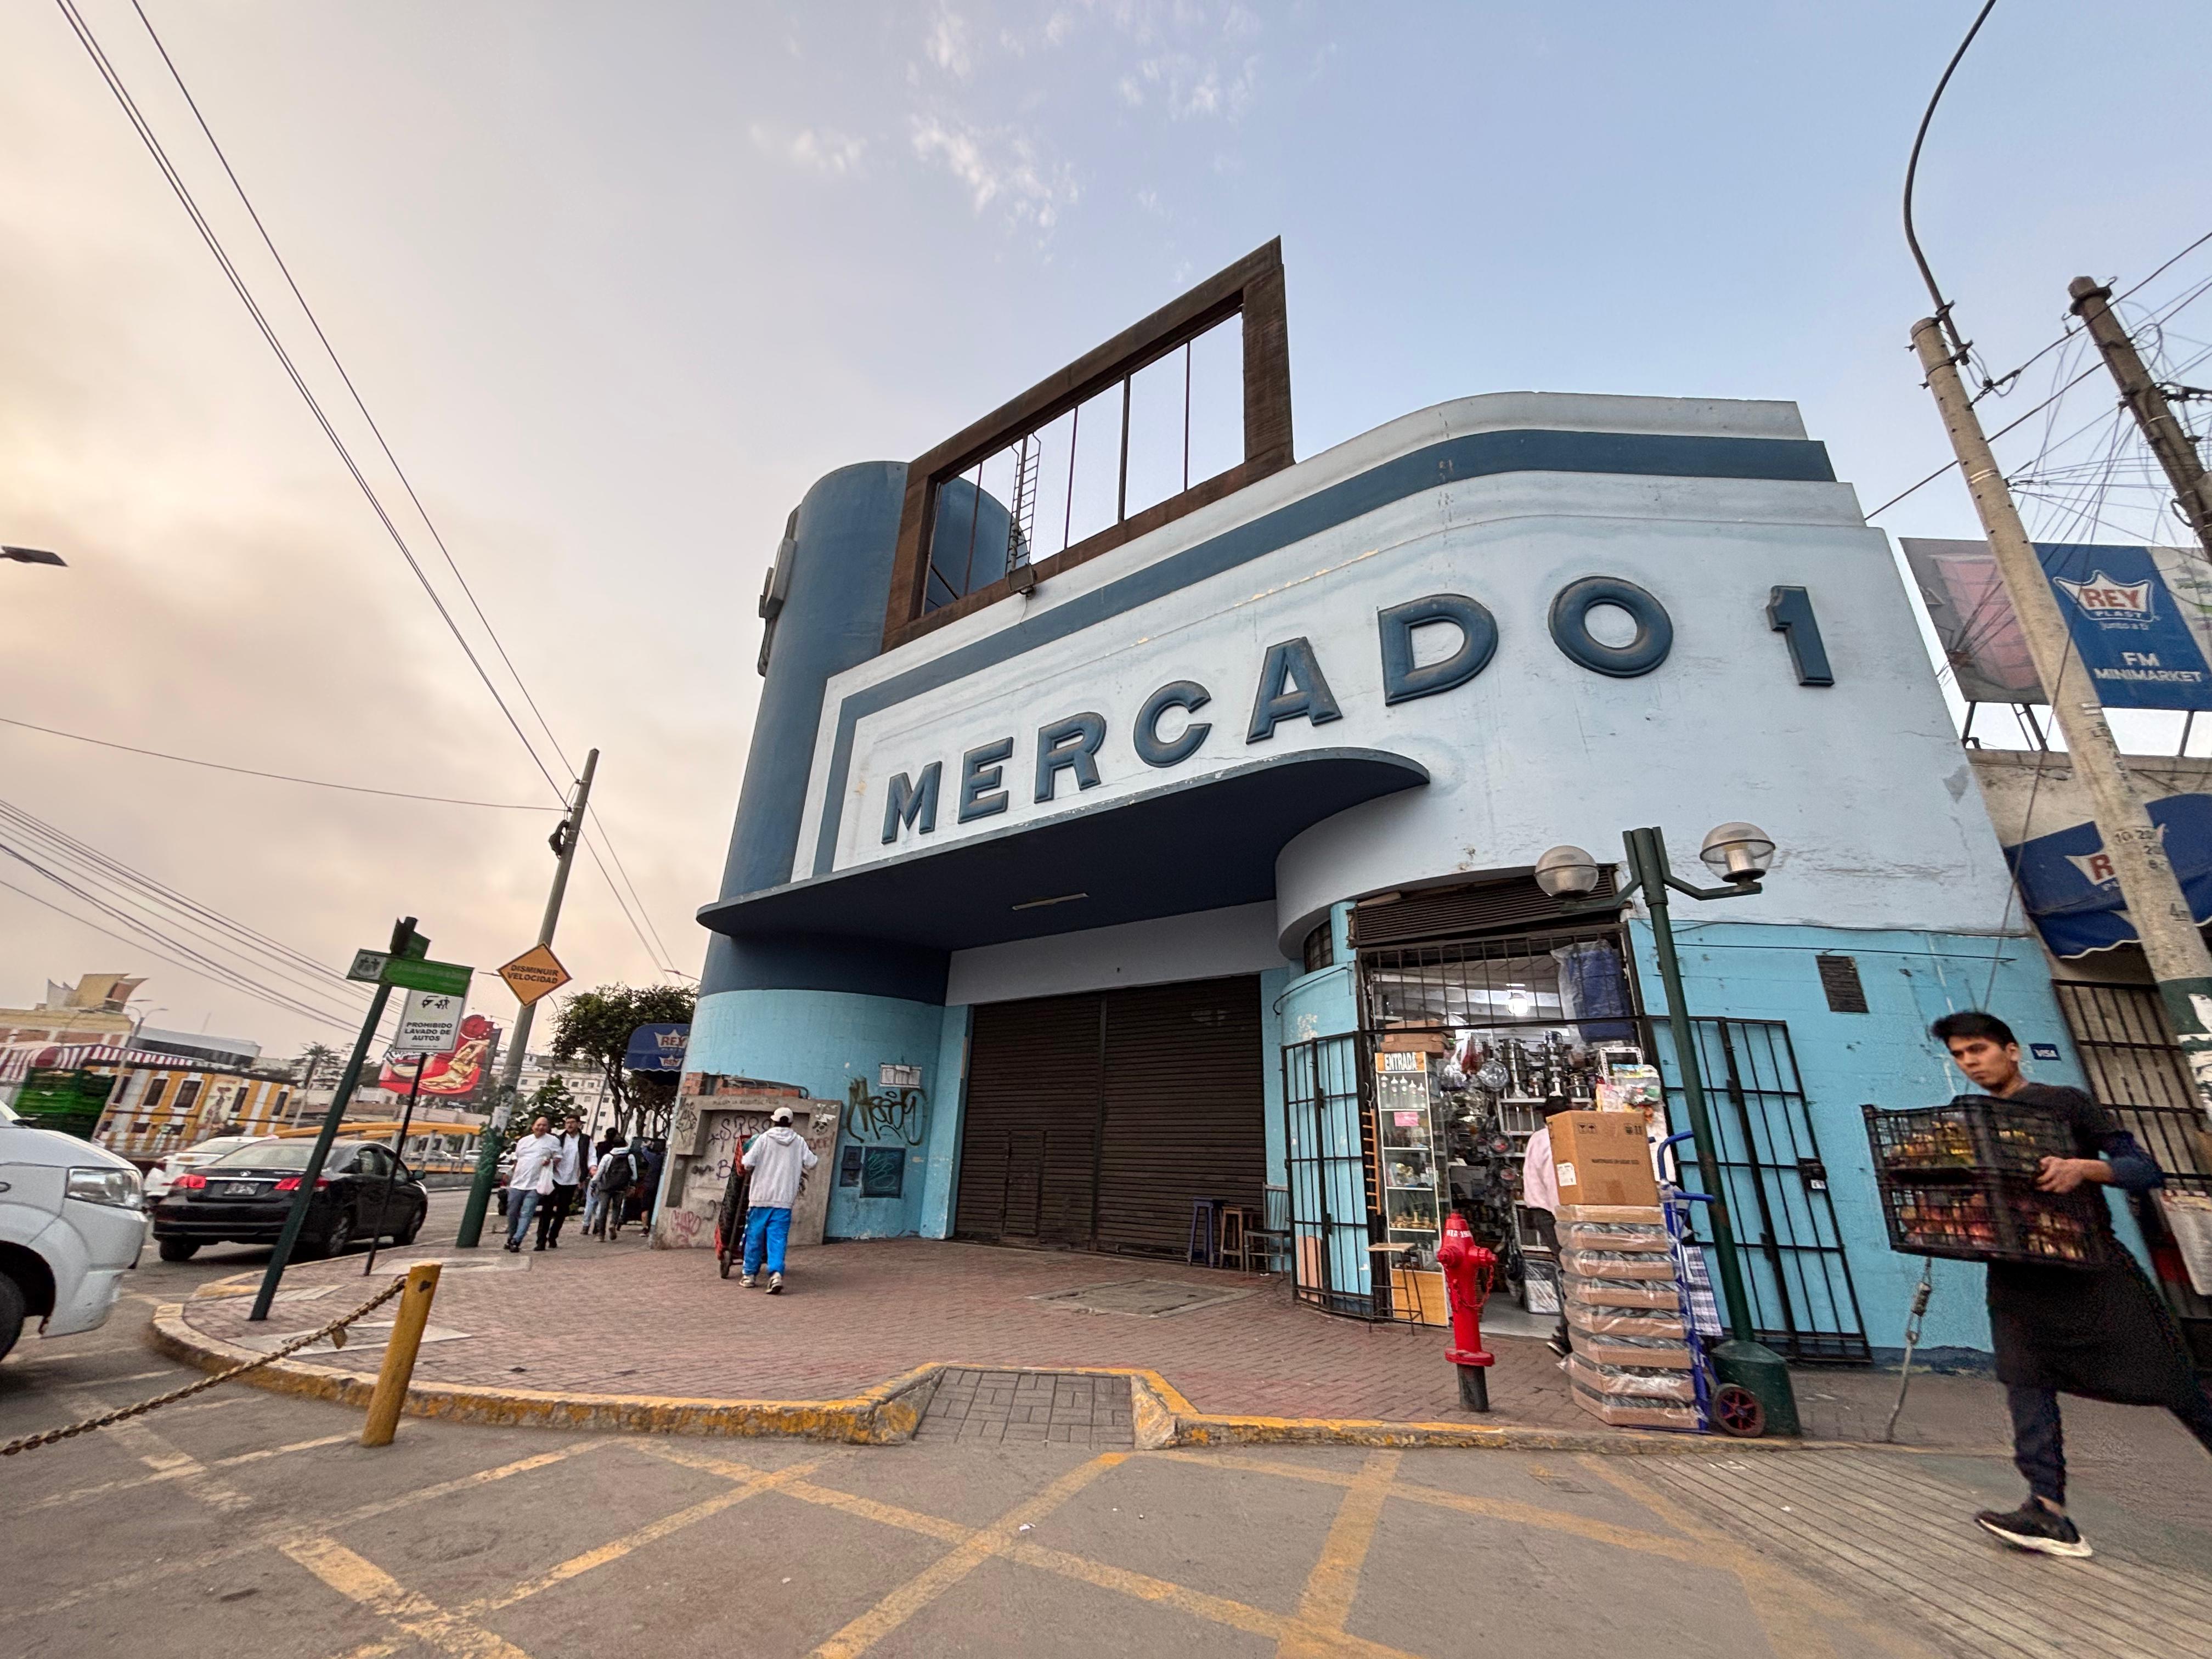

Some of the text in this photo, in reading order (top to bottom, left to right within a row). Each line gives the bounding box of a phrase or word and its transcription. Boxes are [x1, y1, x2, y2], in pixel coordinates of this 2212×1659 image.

[2081, 589, 2141, 608] REY
[2121, 652, 2160, 667] FM
[2094, 668, 2202, 682] MINIMARKET
[881, 575, 1835, 844] MERCADO 1
[511, 964, 559, 977] DISMINUIR
[507, 972, 558, 984] VELOCIDAD
[661, 1036, 686, 1047] REY
[2032, 1048, 2058, 1058] VISA
[1384, 1052, 1418, 1071] ENTRADA
